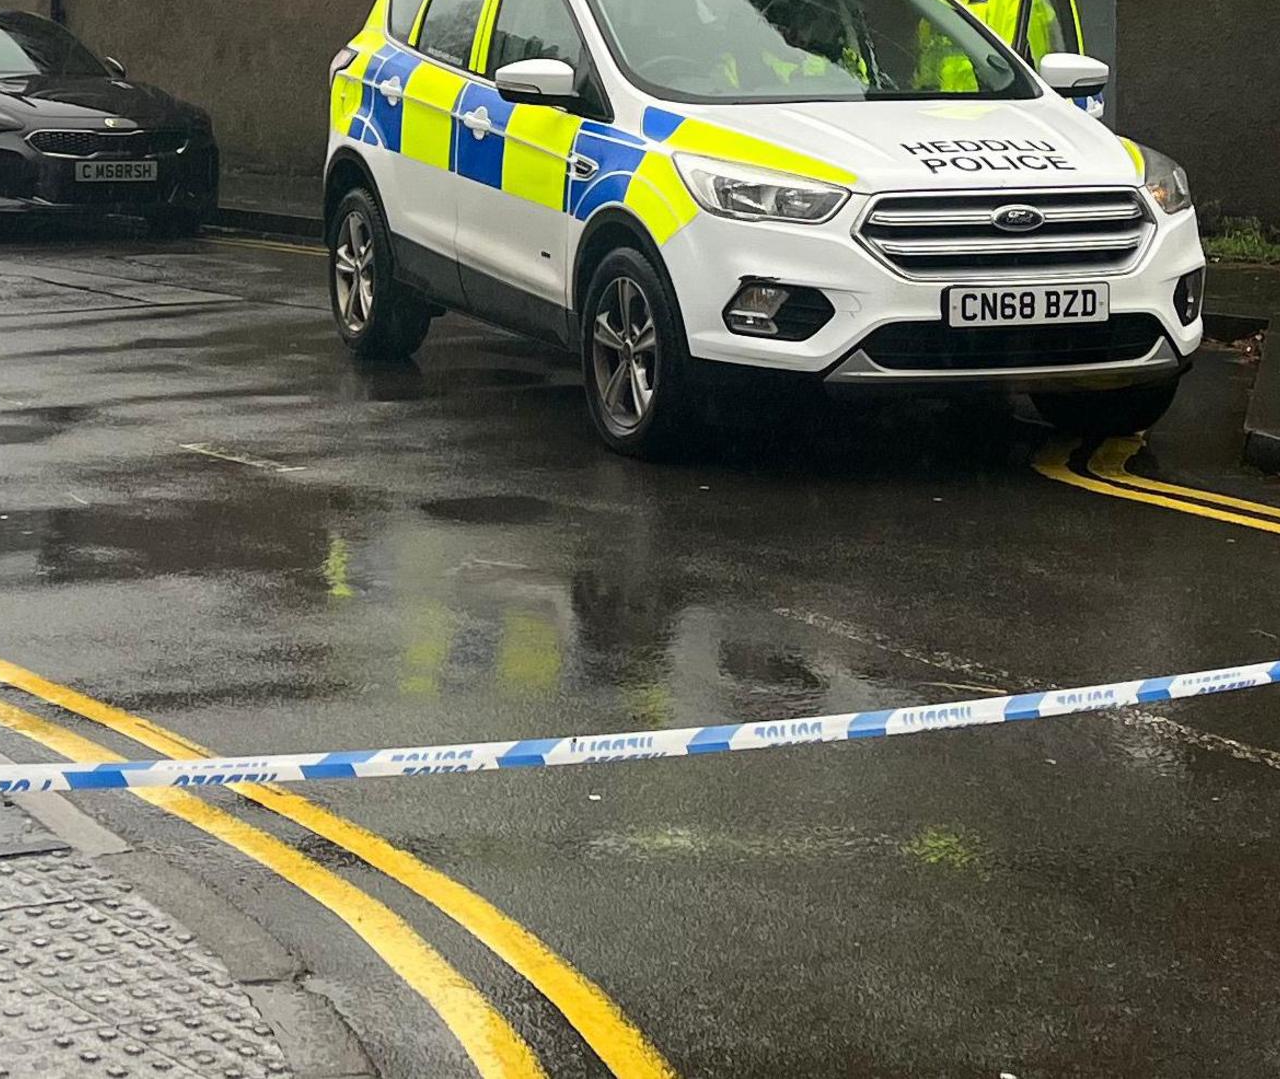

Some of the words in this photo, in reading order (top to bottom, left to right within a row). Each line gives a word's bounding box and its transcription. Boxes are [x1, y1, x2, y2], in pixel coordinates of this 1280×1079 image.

[900, 139, 1057, 155] HEDDLU
[920, 155, 1078, 174] POLICE
[961, 291, 1036, 321] CN68
[1044, 289, 1097, 318] BZD
